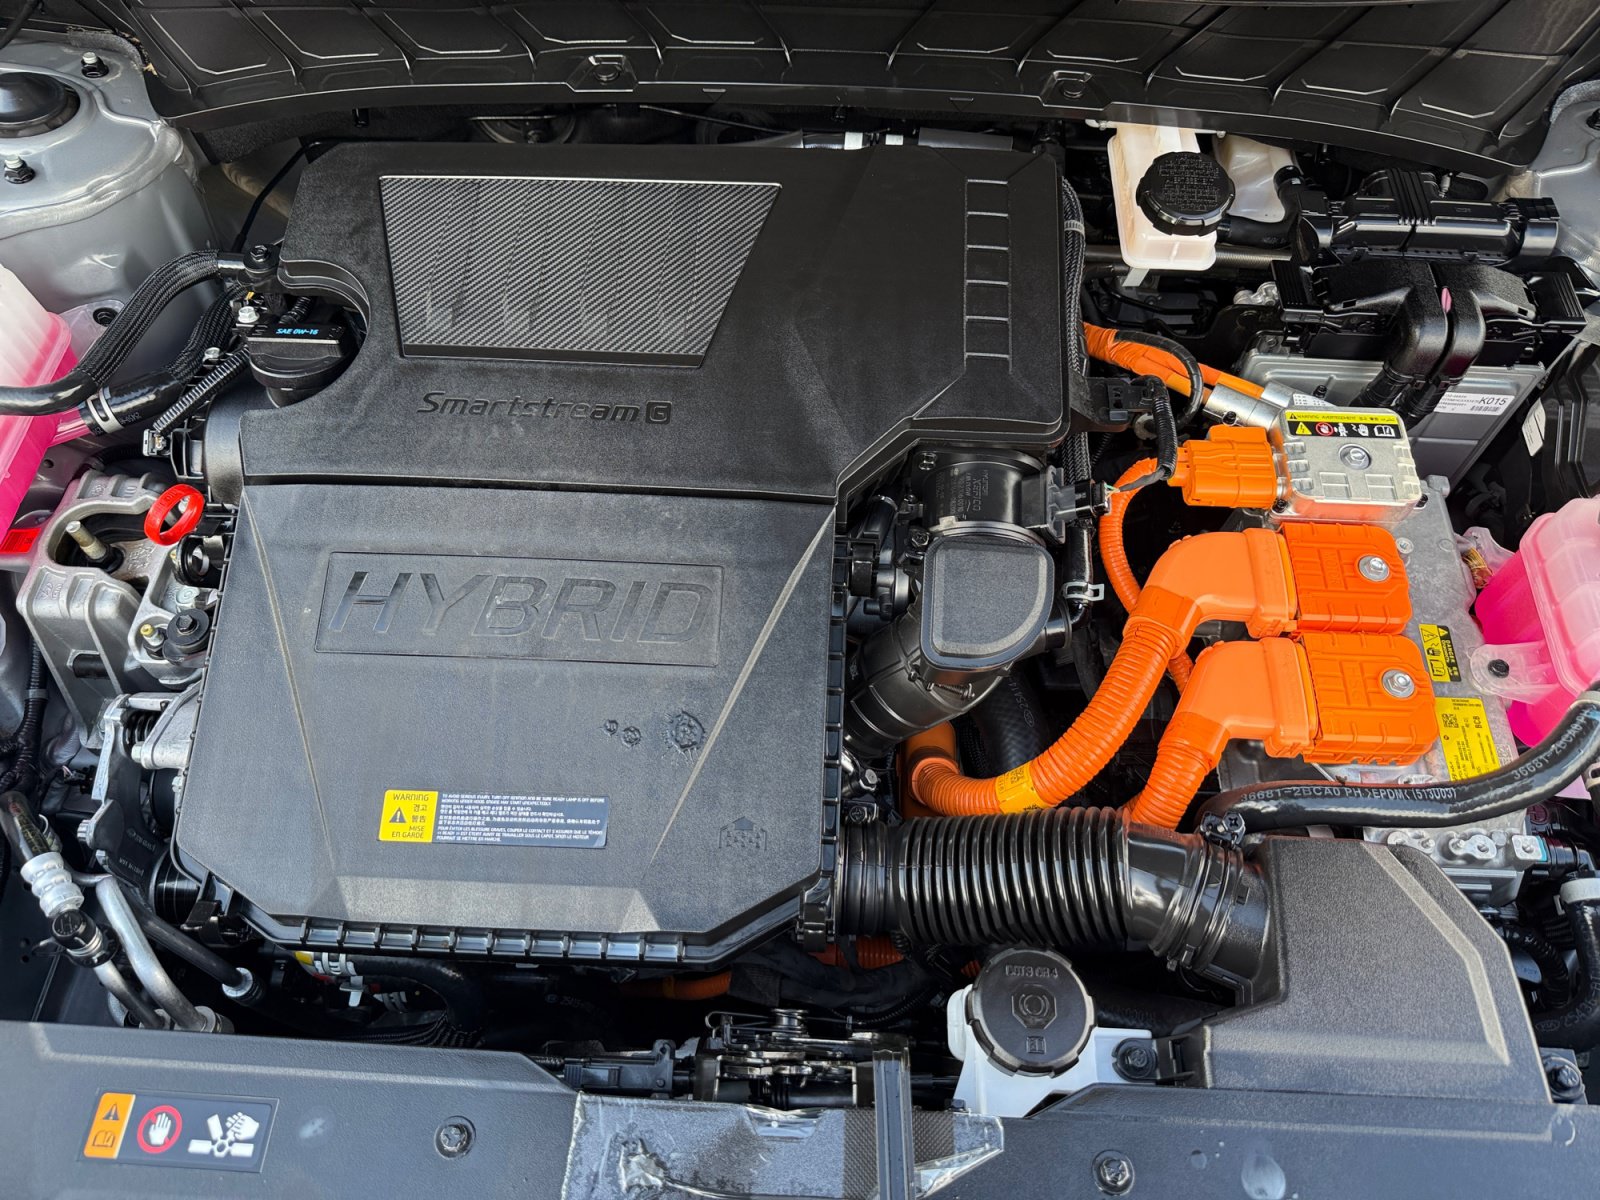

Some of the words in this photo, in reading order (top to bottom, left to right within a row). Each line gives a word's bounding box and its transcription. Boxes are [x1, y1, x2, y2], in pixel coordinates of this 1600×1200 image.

[416, 390, 640, 422] Smartstream
[1478, 396, 1508, 406] K015
[328, 571, 712, 644] HYBRID
[1345, 788, 1362, 798] PH
